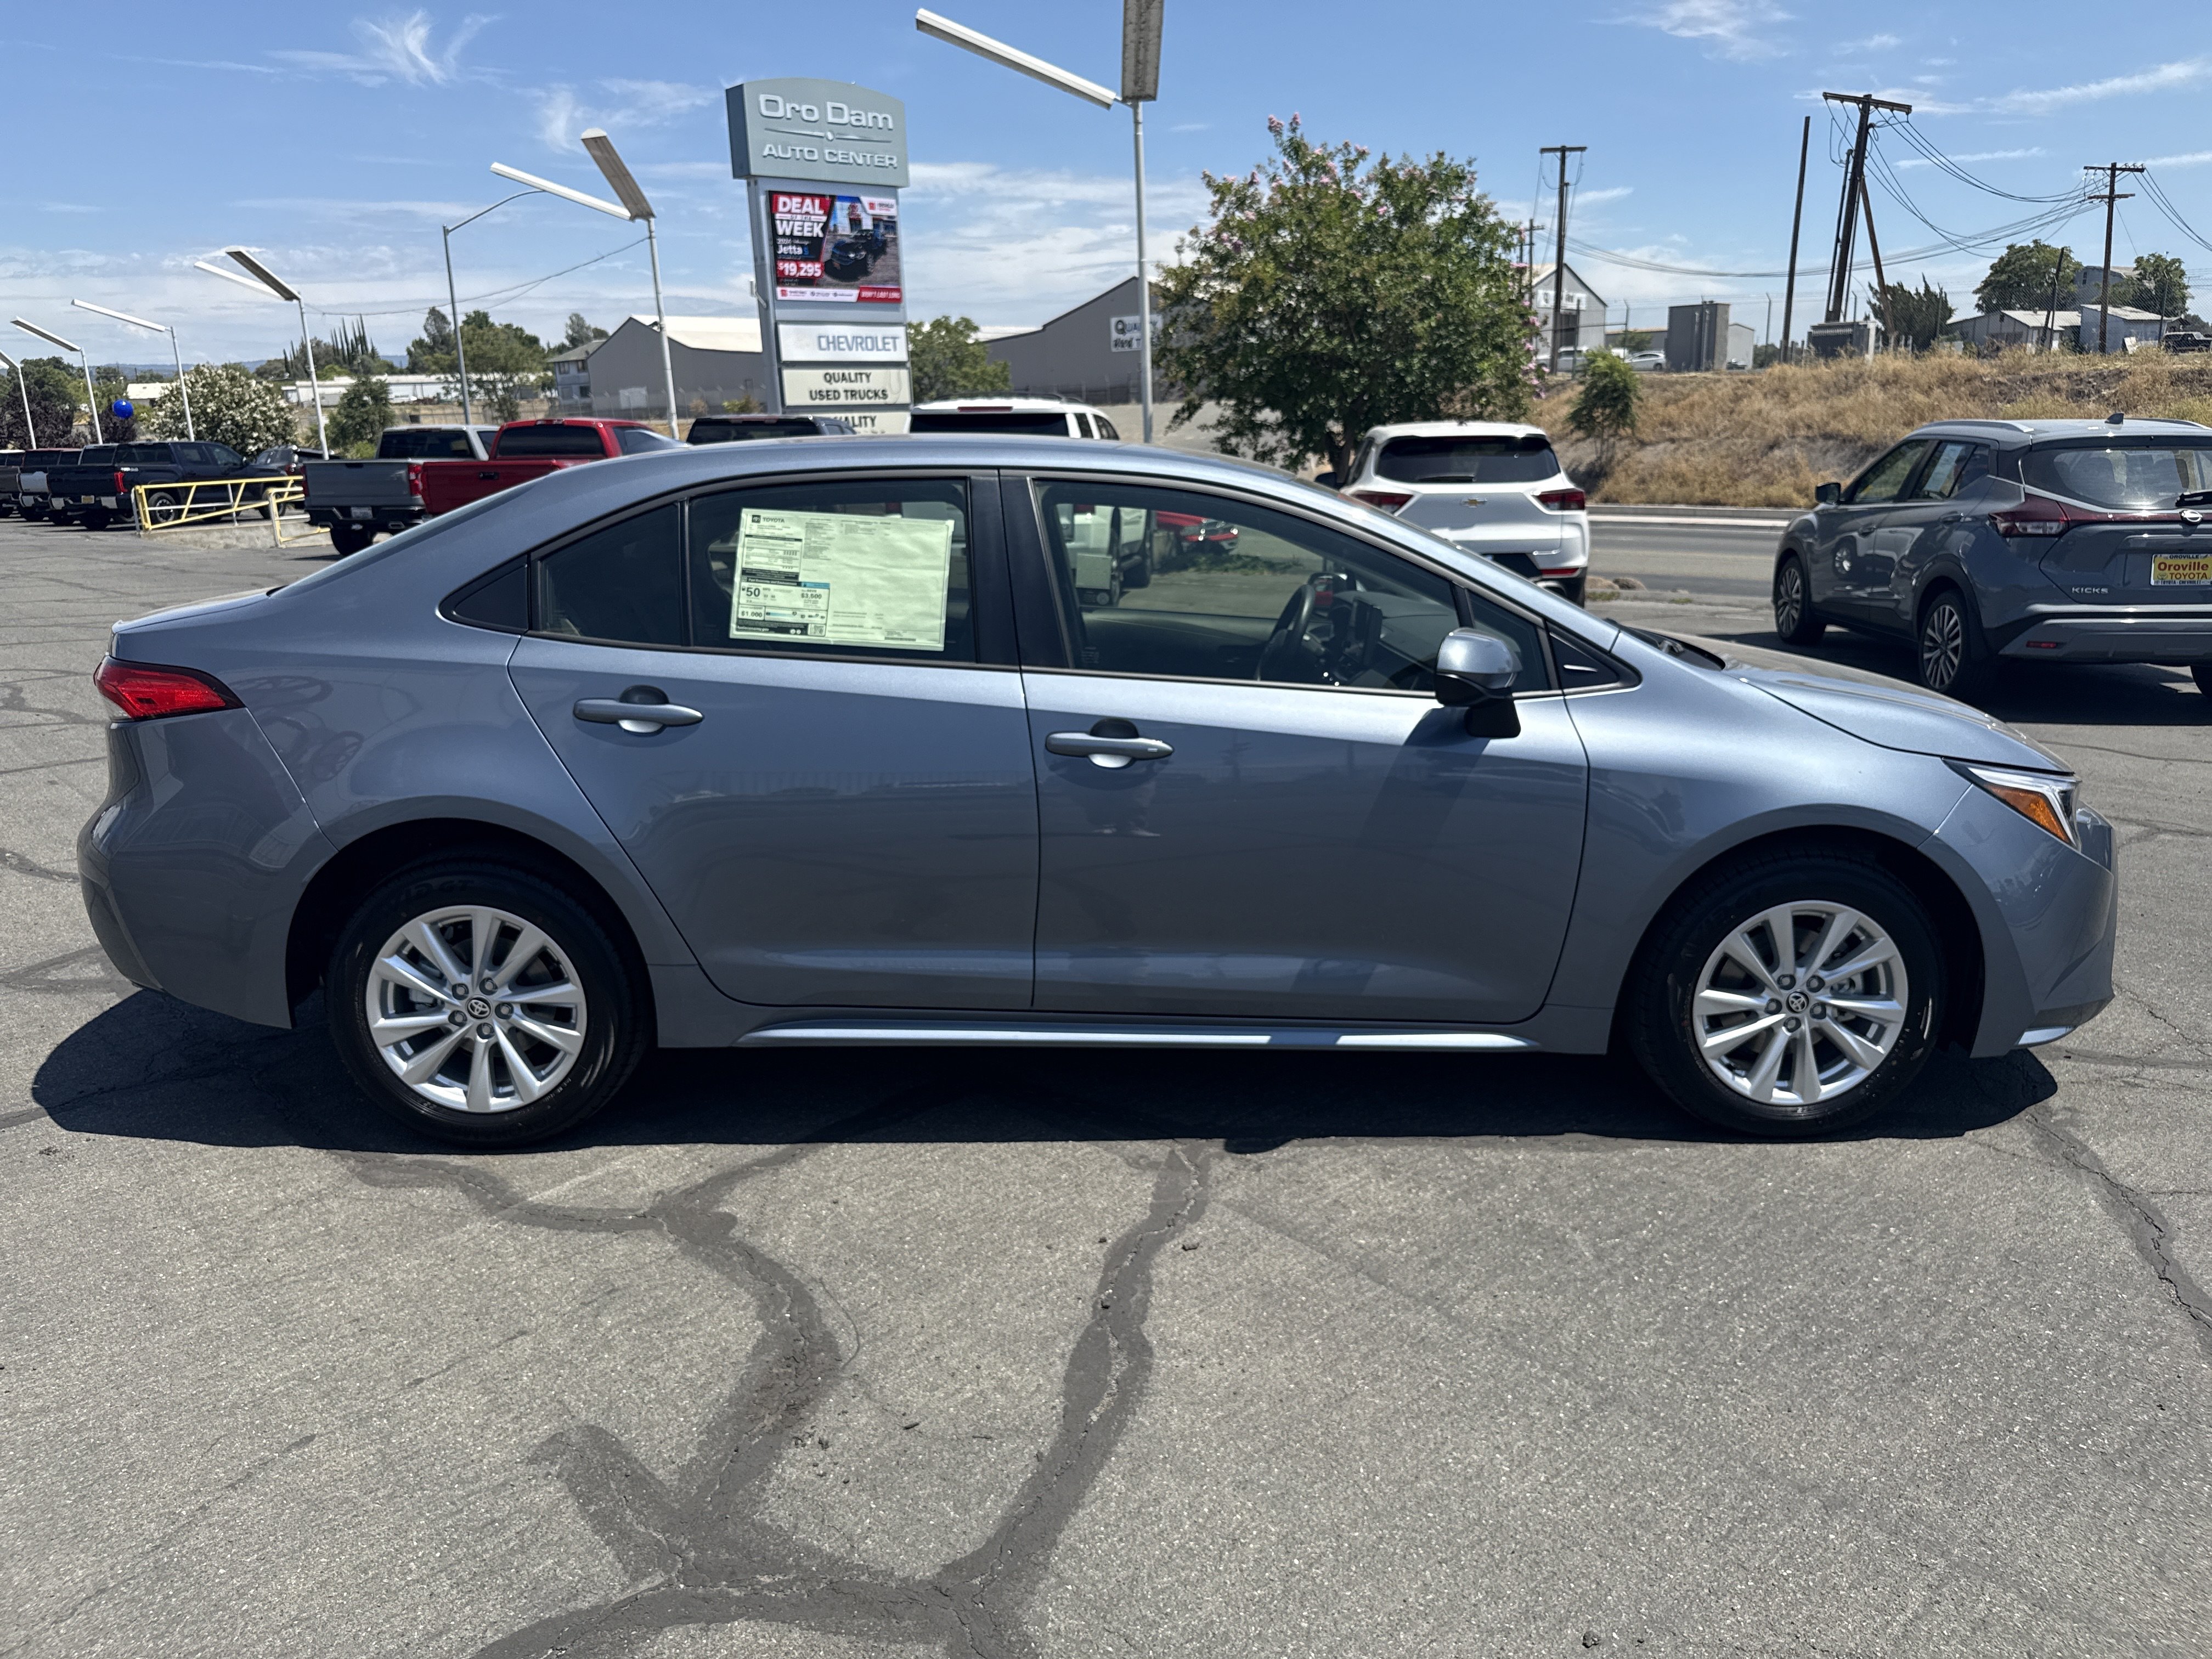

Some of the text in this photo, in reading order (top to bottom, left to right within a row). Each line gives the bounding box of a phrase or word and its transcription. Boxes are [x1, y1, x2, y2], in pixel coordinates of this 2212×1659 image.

[759, 94, 893, 129] Oro Dam
[763, 144, 898, 168] AUTO CENTER
[777, 196, 825, 215] DEAL
[775, 220, 824, 238] WEEK
[777, 245, 803, 255] Jetta
[777, 262, 822, 277] $19,295
[817, 335, 899, 351] CHEVROLET
[823, 373, 871, 384] QUALITY
[810, 390, 888, 400] USED TRUCKS
[834, 416, 877, 427] ALITY
[2158, 562, 2209, 571] Oroville
[746, 587, 760, 597] 50
